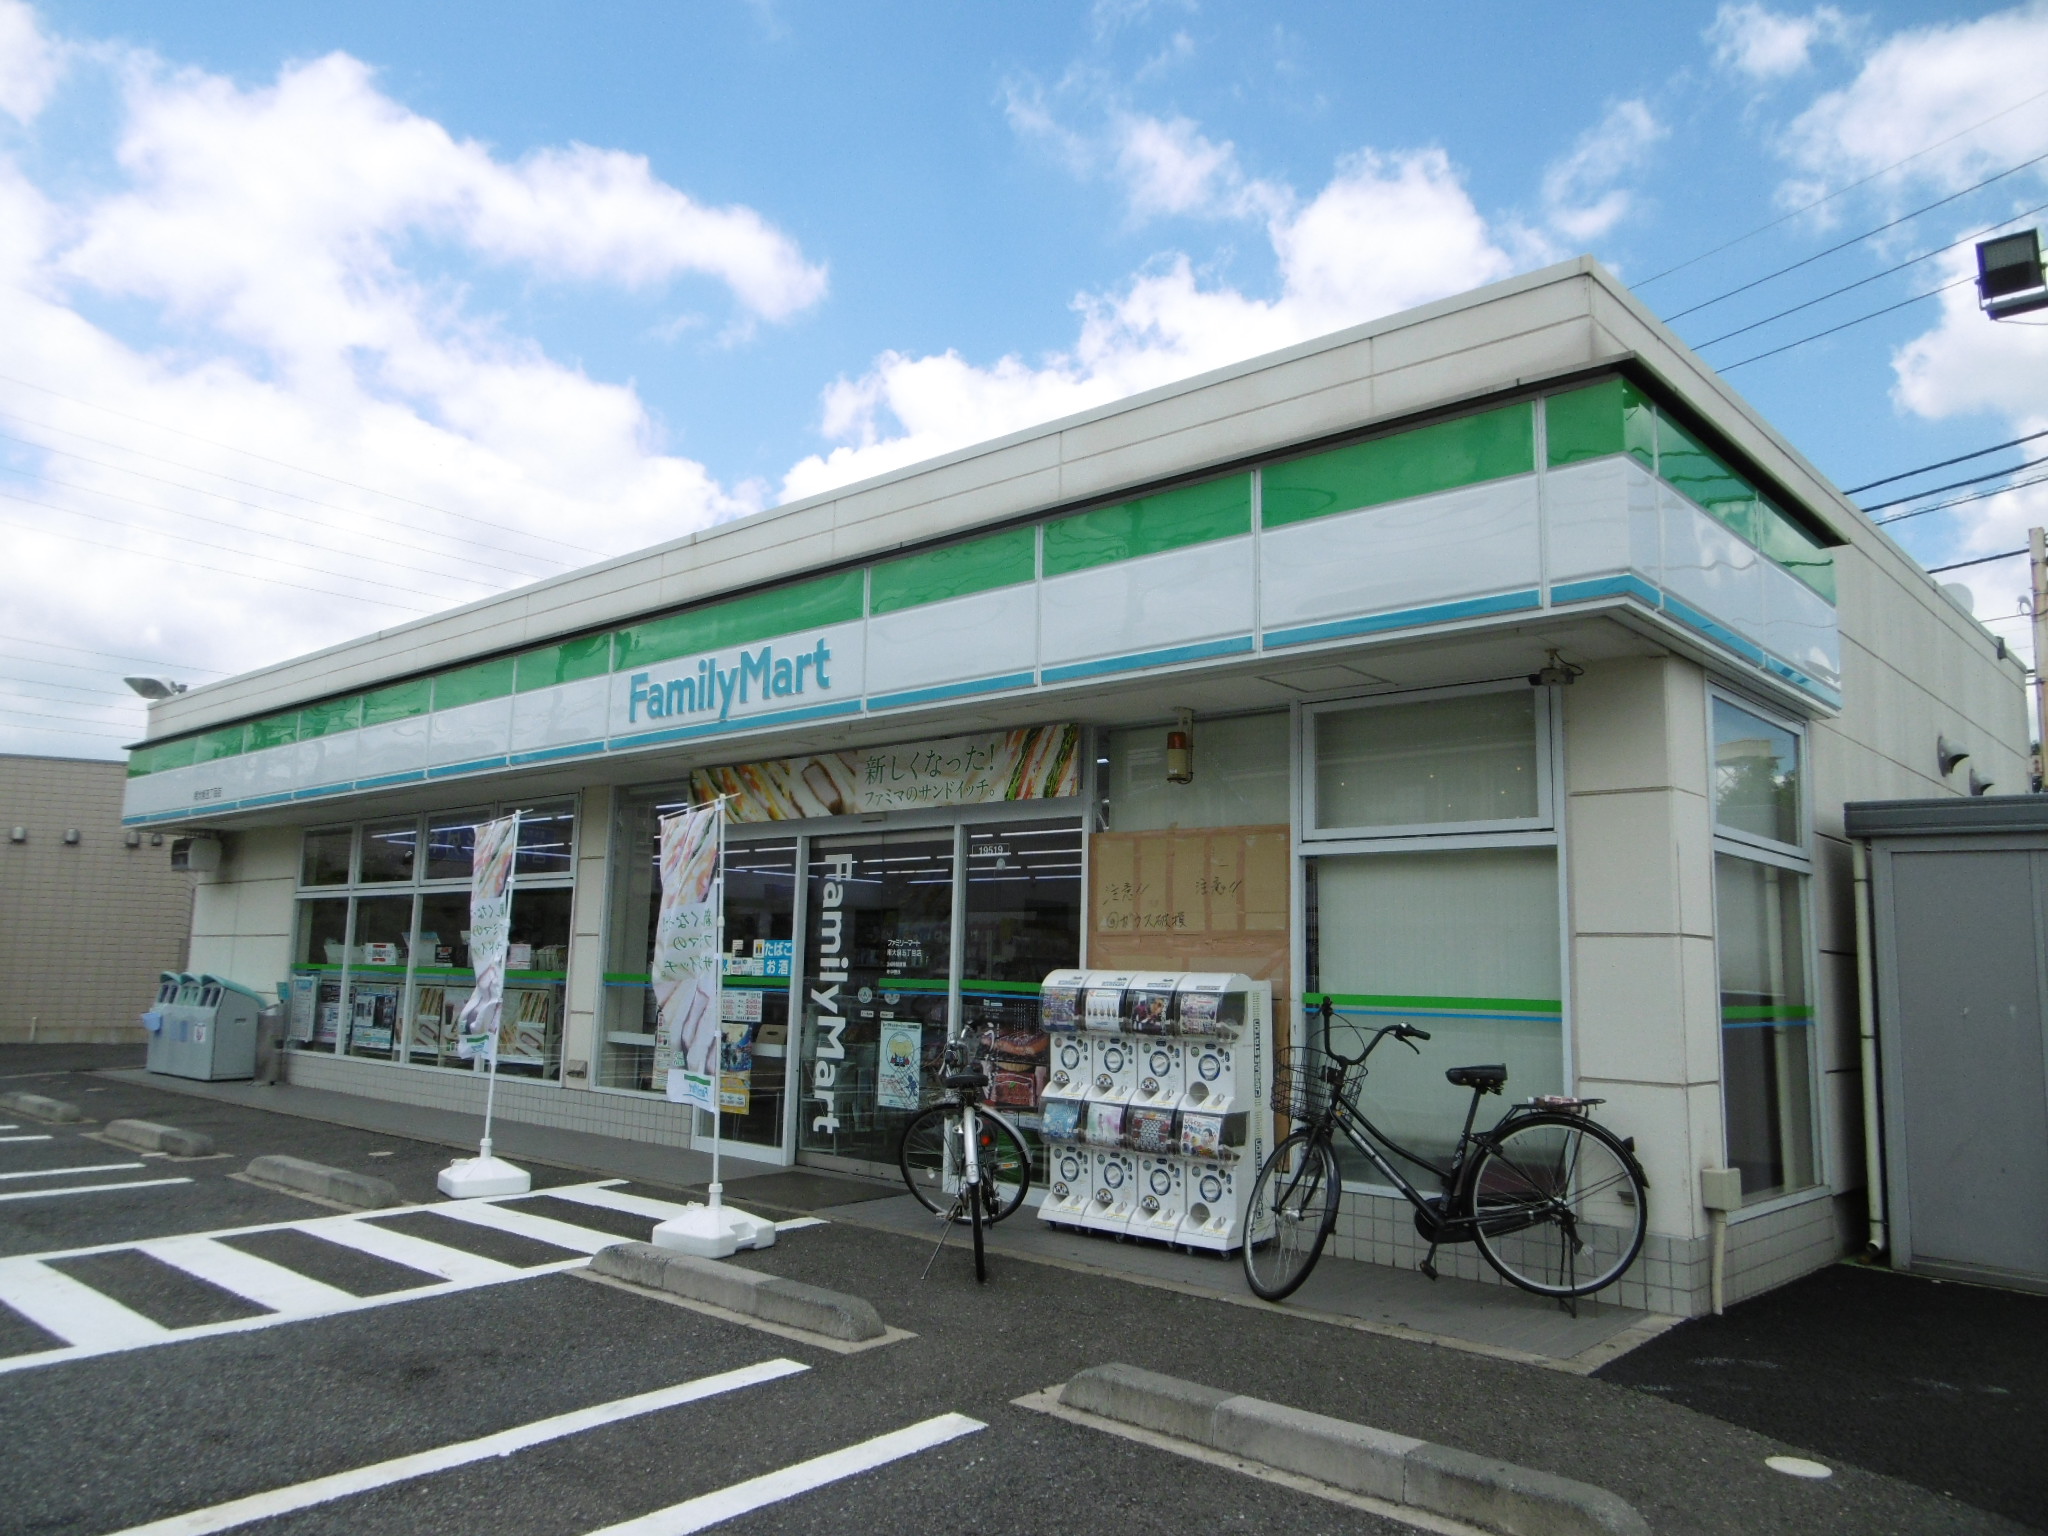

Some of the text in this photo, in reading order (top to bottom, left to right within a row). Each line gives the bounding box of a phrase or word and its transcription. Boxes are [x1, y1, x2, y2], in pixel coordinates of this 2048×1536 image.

[629, 638, 832, 723] FamilyMart
[864, 743, 995, 785] 新しくなった!
[864, 778, 996, 807] ファミマのサンドイッチ。
[978, 844, 1004, 856] 19519
[764, 942, 793, 957] たばこ
[887, 939, 921, 948] ファミリーマート
[766, 959, 789, 975] お酒
[811, 853, 853, 1134] FamilyMart
